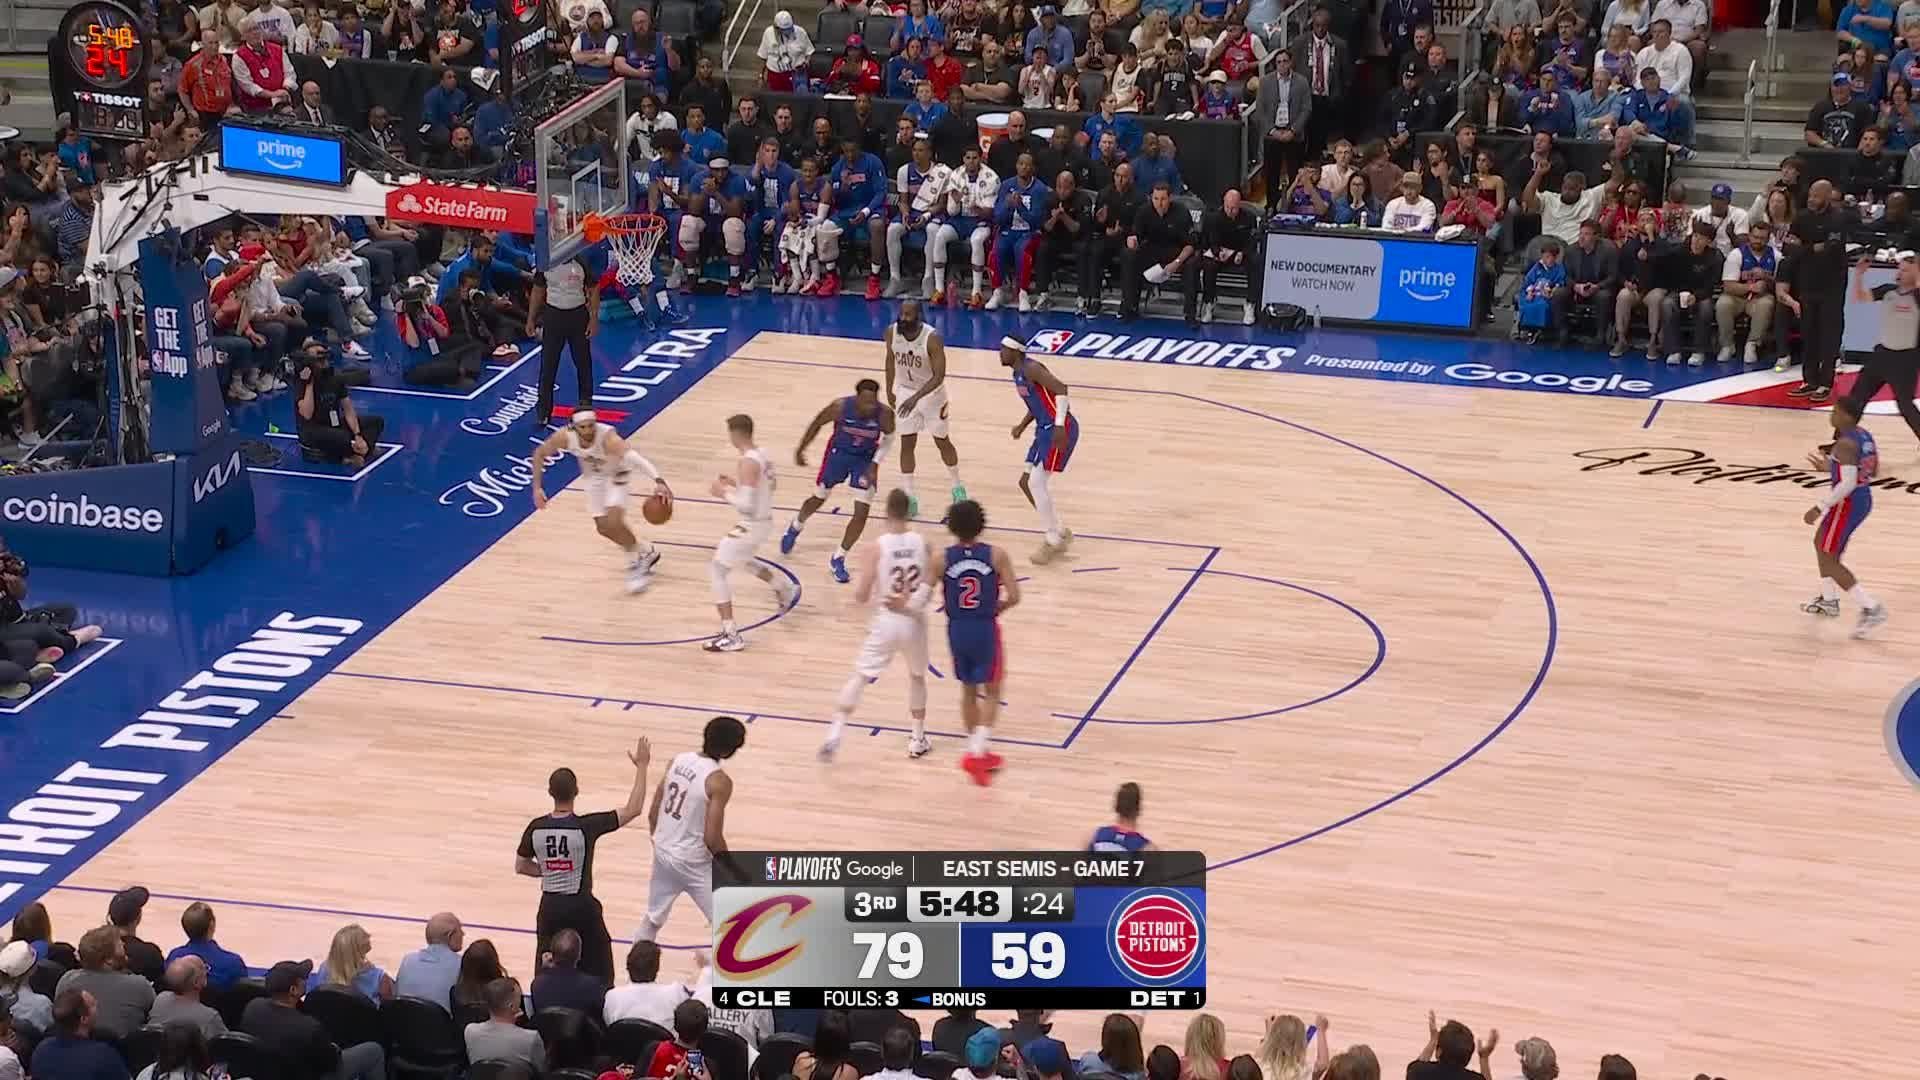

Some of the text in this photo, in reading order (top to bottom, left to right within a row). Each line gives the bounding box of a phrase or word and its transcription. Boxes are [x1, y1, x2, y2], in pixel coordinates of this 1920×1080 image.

[88, 24, 133, 48] 5:48
[86, 45, 128, 79] 24
[92, 92, 141, 107] TISSOT
[257, 139, 305, 158] prime
[1271, 260, 1377, 276] NEW DOCUMENTARY
[1399, 266, 1456, 287] prime
[1291, 277, 1355, 292] WATCH NOW
[154, 307, 178, 328] GET
[156, 328, 180, 350] THE
[1064, 332, 1297, 370] PLAYOFFS
[163, 351, 187, 378] App
[592, 327, 728, 403] ULTRA
[895, 351, 922, 368] CAVS
[1304, 353, 1654, 393] Presented by Google
[3, 493, 163, 532] coinbase
[890, 565, 919, 593] 32
[959, 576, 981, 609] 2
[100, 611, 364, 751] PISTONS
[664, 782, 687, 820] 31
[546, 836, 569, 858] 24
[706, 1008, 750, 1023] ALLERY
